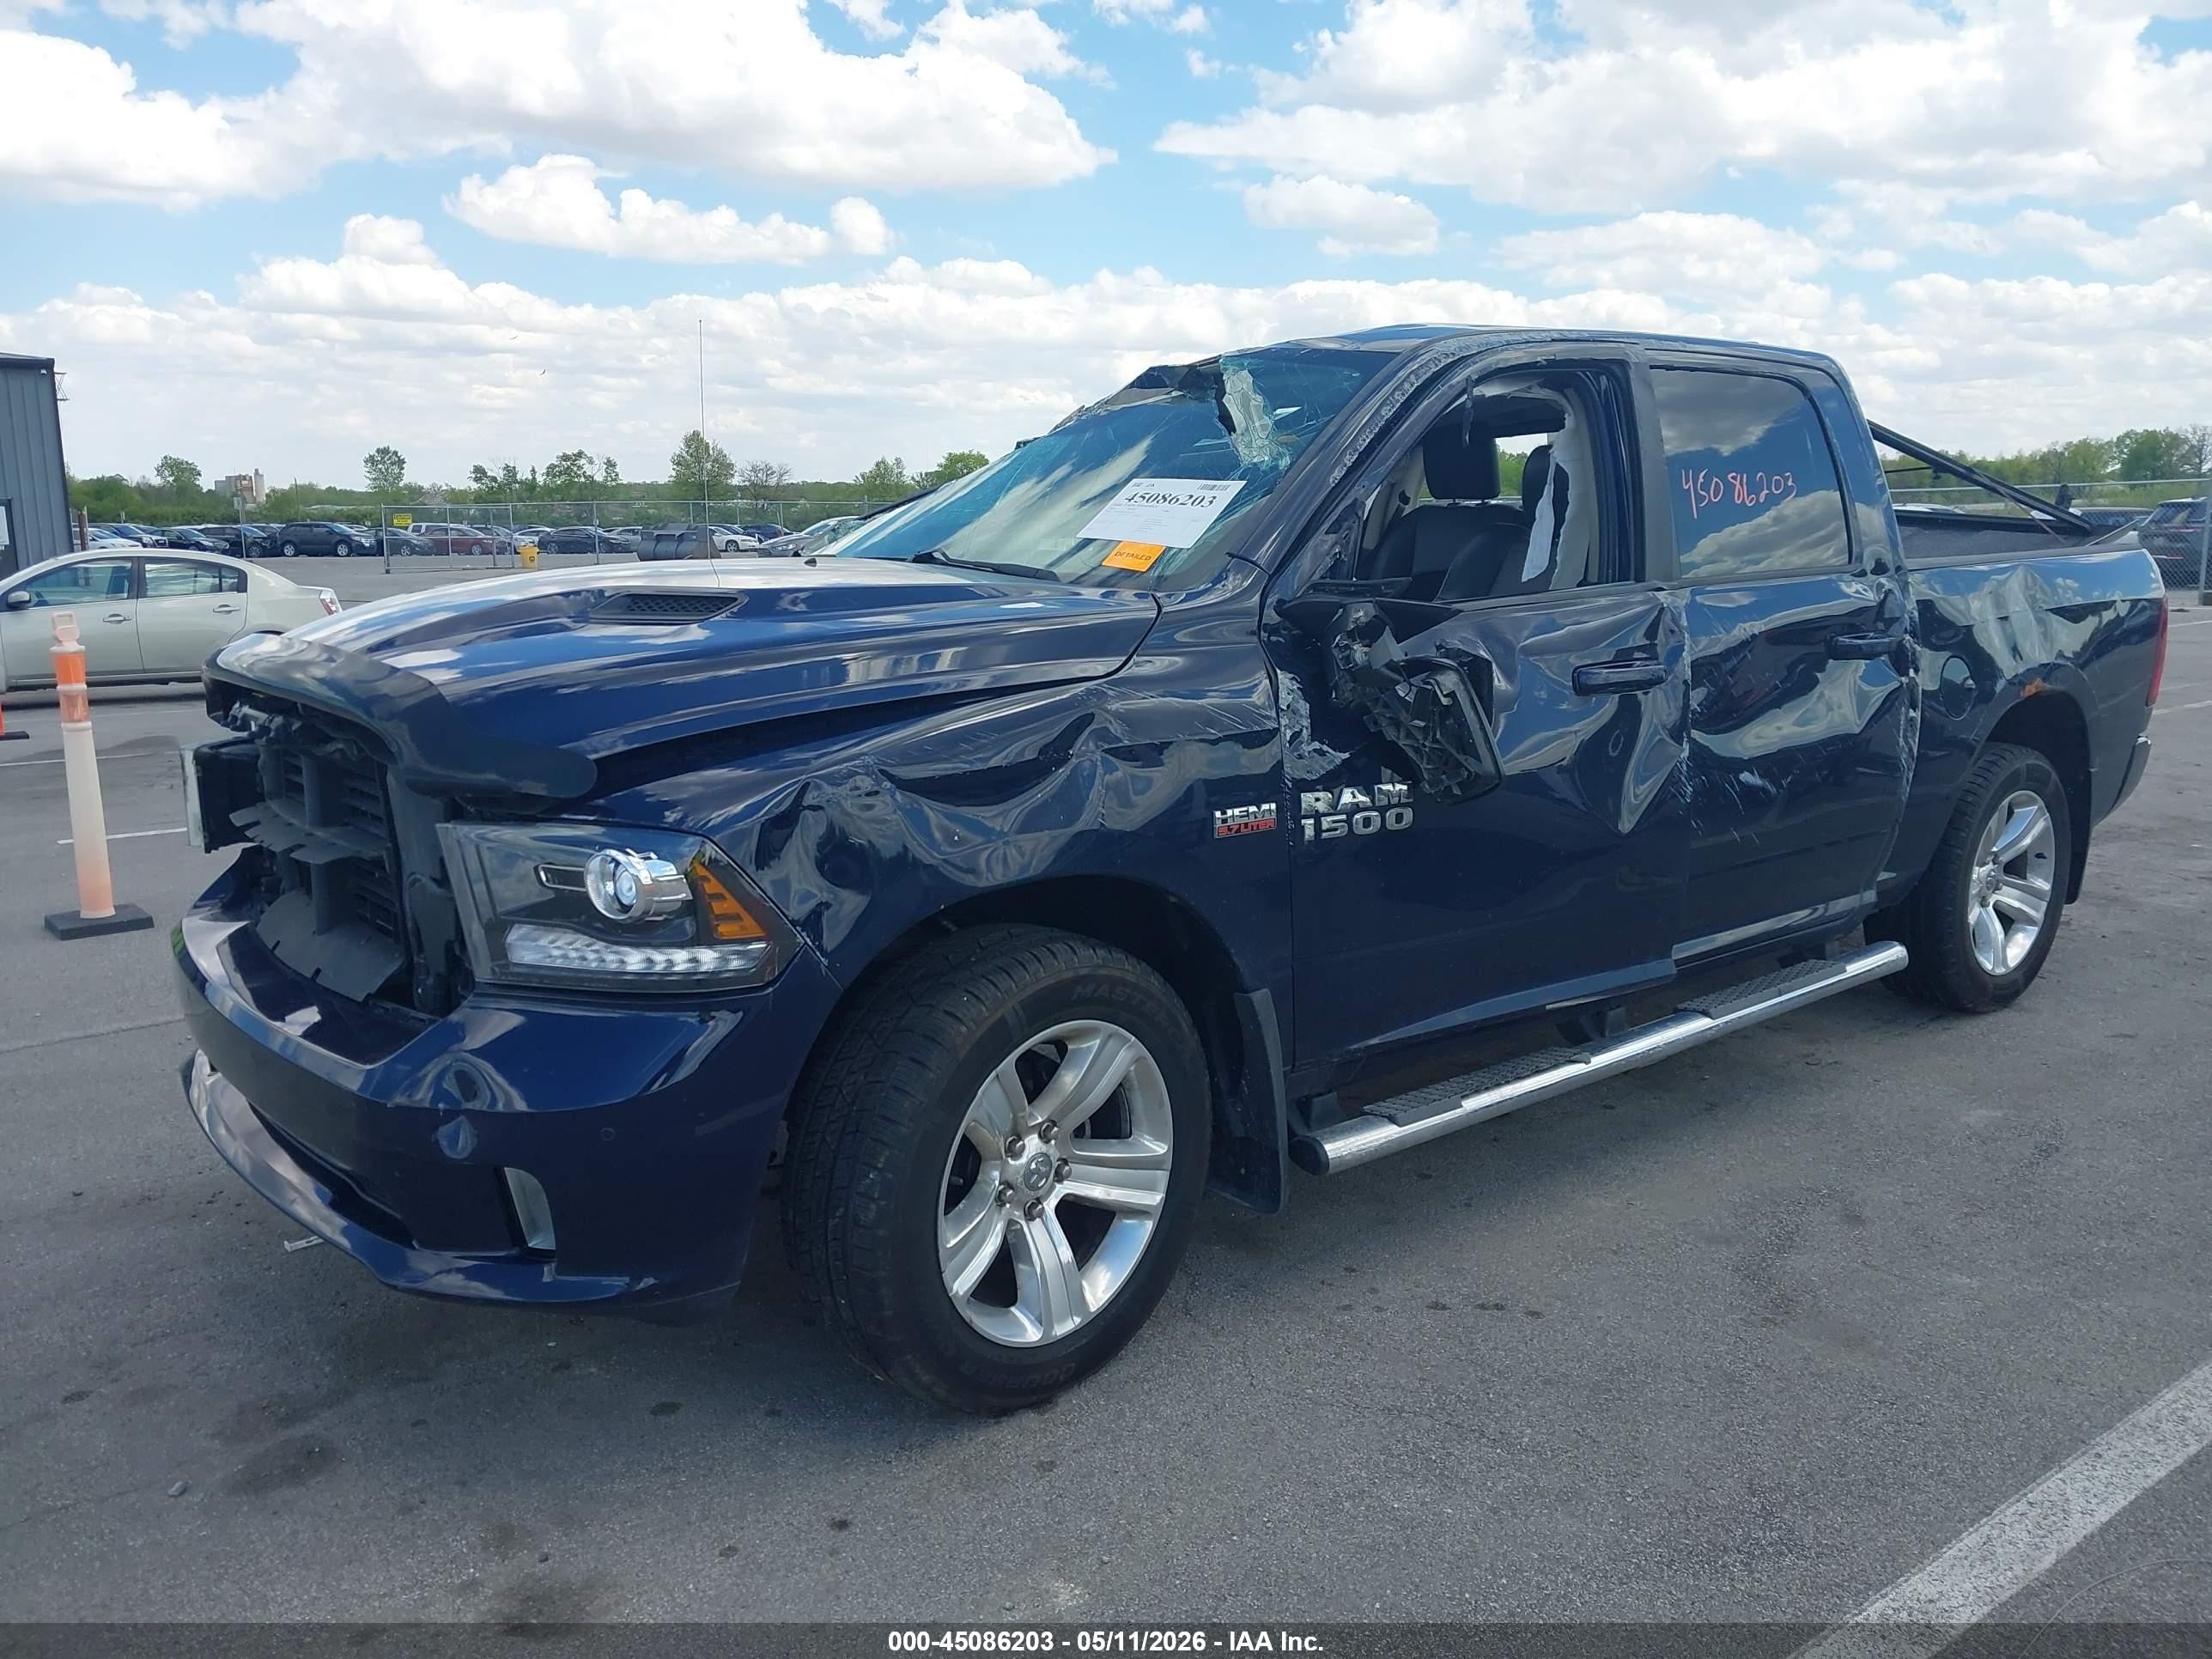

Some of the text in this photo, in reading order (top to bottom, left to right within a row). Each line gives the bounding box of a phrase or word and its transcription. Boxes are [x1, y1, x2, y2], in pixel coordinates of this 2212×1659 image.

[1124, 492, 1218, 508] 45086203
[1114, 551, 1152, 561] DETAILED
[1300, 781, 1414, 815] RAM
[1213, 803, 1277, 824] HEMI
[1218, 824, 1239, 836] 5.7
[1300, 807, 1413, 842] 1500
